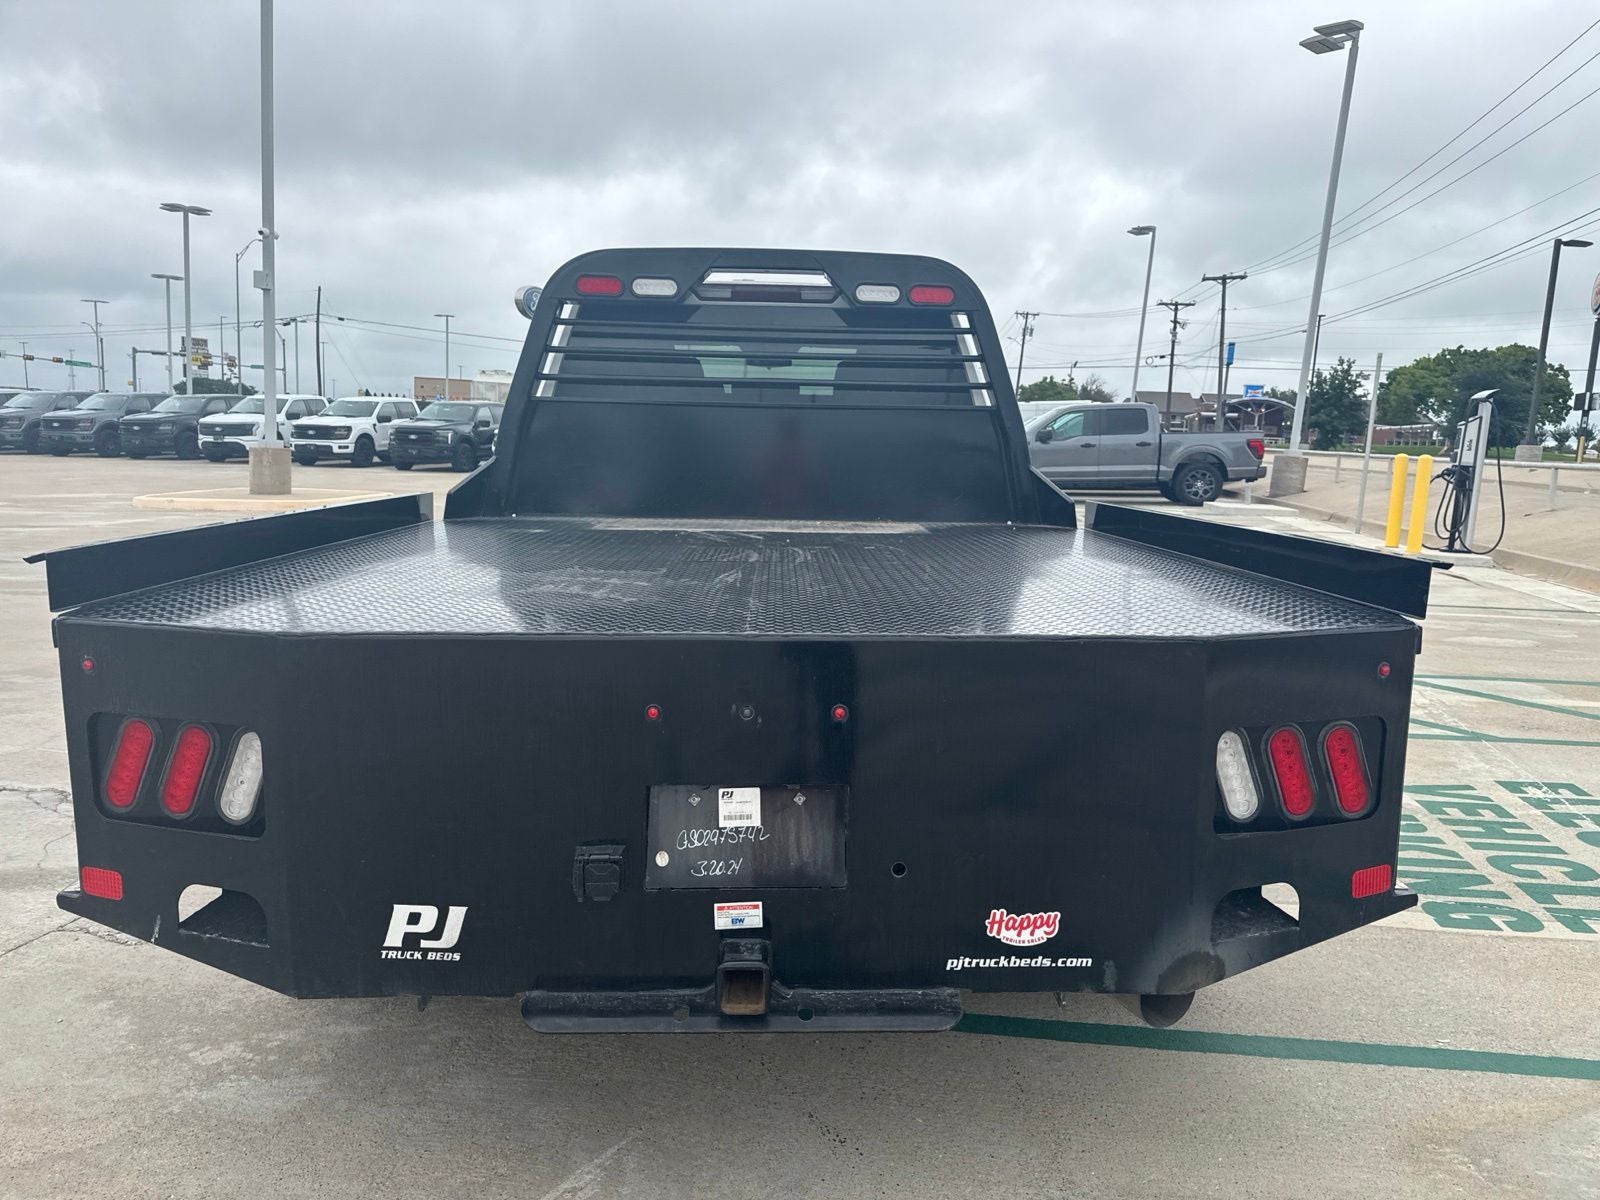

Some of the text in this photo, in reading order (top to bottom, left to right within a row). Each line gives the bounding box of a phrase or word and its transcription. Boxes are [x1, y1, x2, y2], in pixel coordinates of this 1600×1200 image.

[721, 790, 734, 799] PJ
[1494, 780, 1600, 848] ELE
[691, 858, 743, 876] 3.20.24
[382, 903, 469, 949] PJ
[986, 909, 1060, 938] Happy
[1002, 935, 1045, 945] TRAILER SALES
[381, 950, 461, 961] TRUCK BEDS
[946, 955, 1092, 971] pjtruckbeds.com
